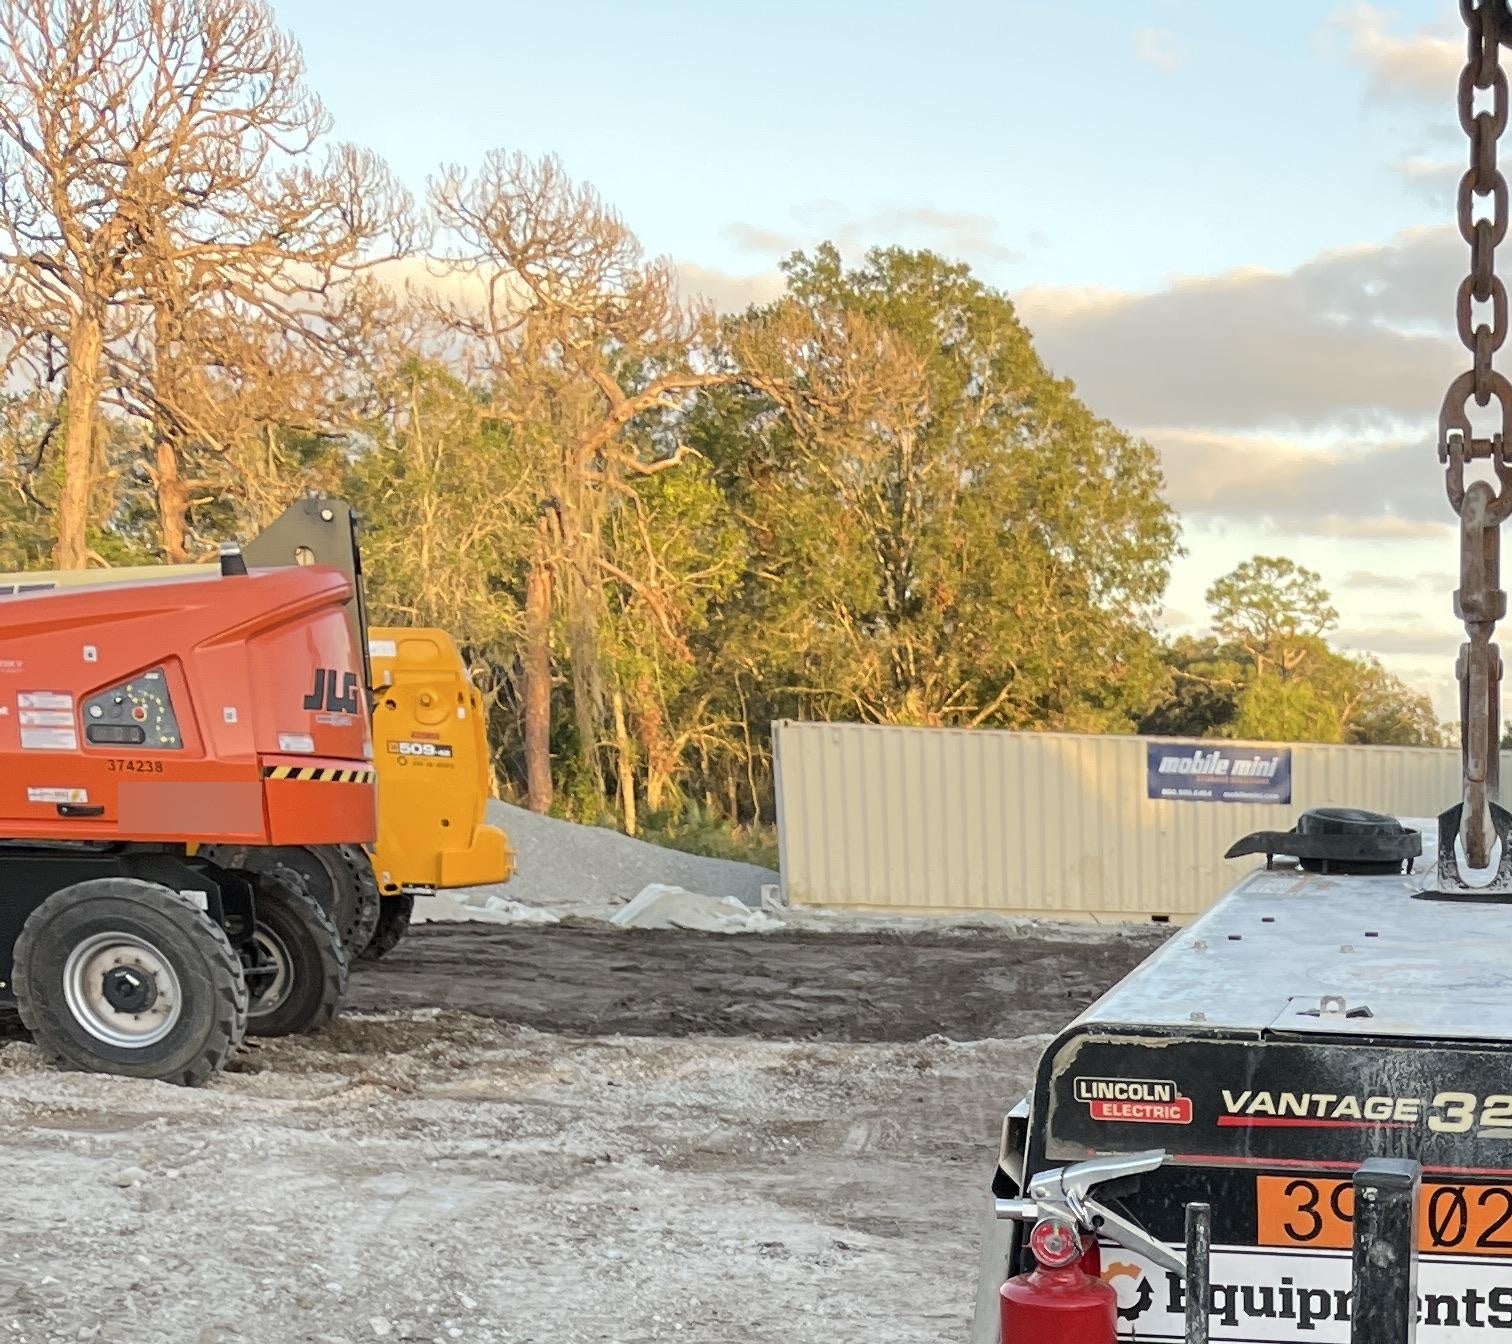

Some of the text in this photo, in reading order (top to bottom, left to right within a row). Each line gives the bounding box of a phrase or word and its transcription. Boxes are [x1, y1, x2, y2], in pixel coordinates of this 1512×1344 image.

[303, 669, 358, 714] JLG
[107, 759, 163, 772] 374238
[1158, 750, 1279, 778] mobile mini
[1080, 1081, 1171, 1101] LINCOLN
[1101, 1103, 1182, 1119] ELECTRIC
[1221, 1089, 1419, 1122] VANTAGE
